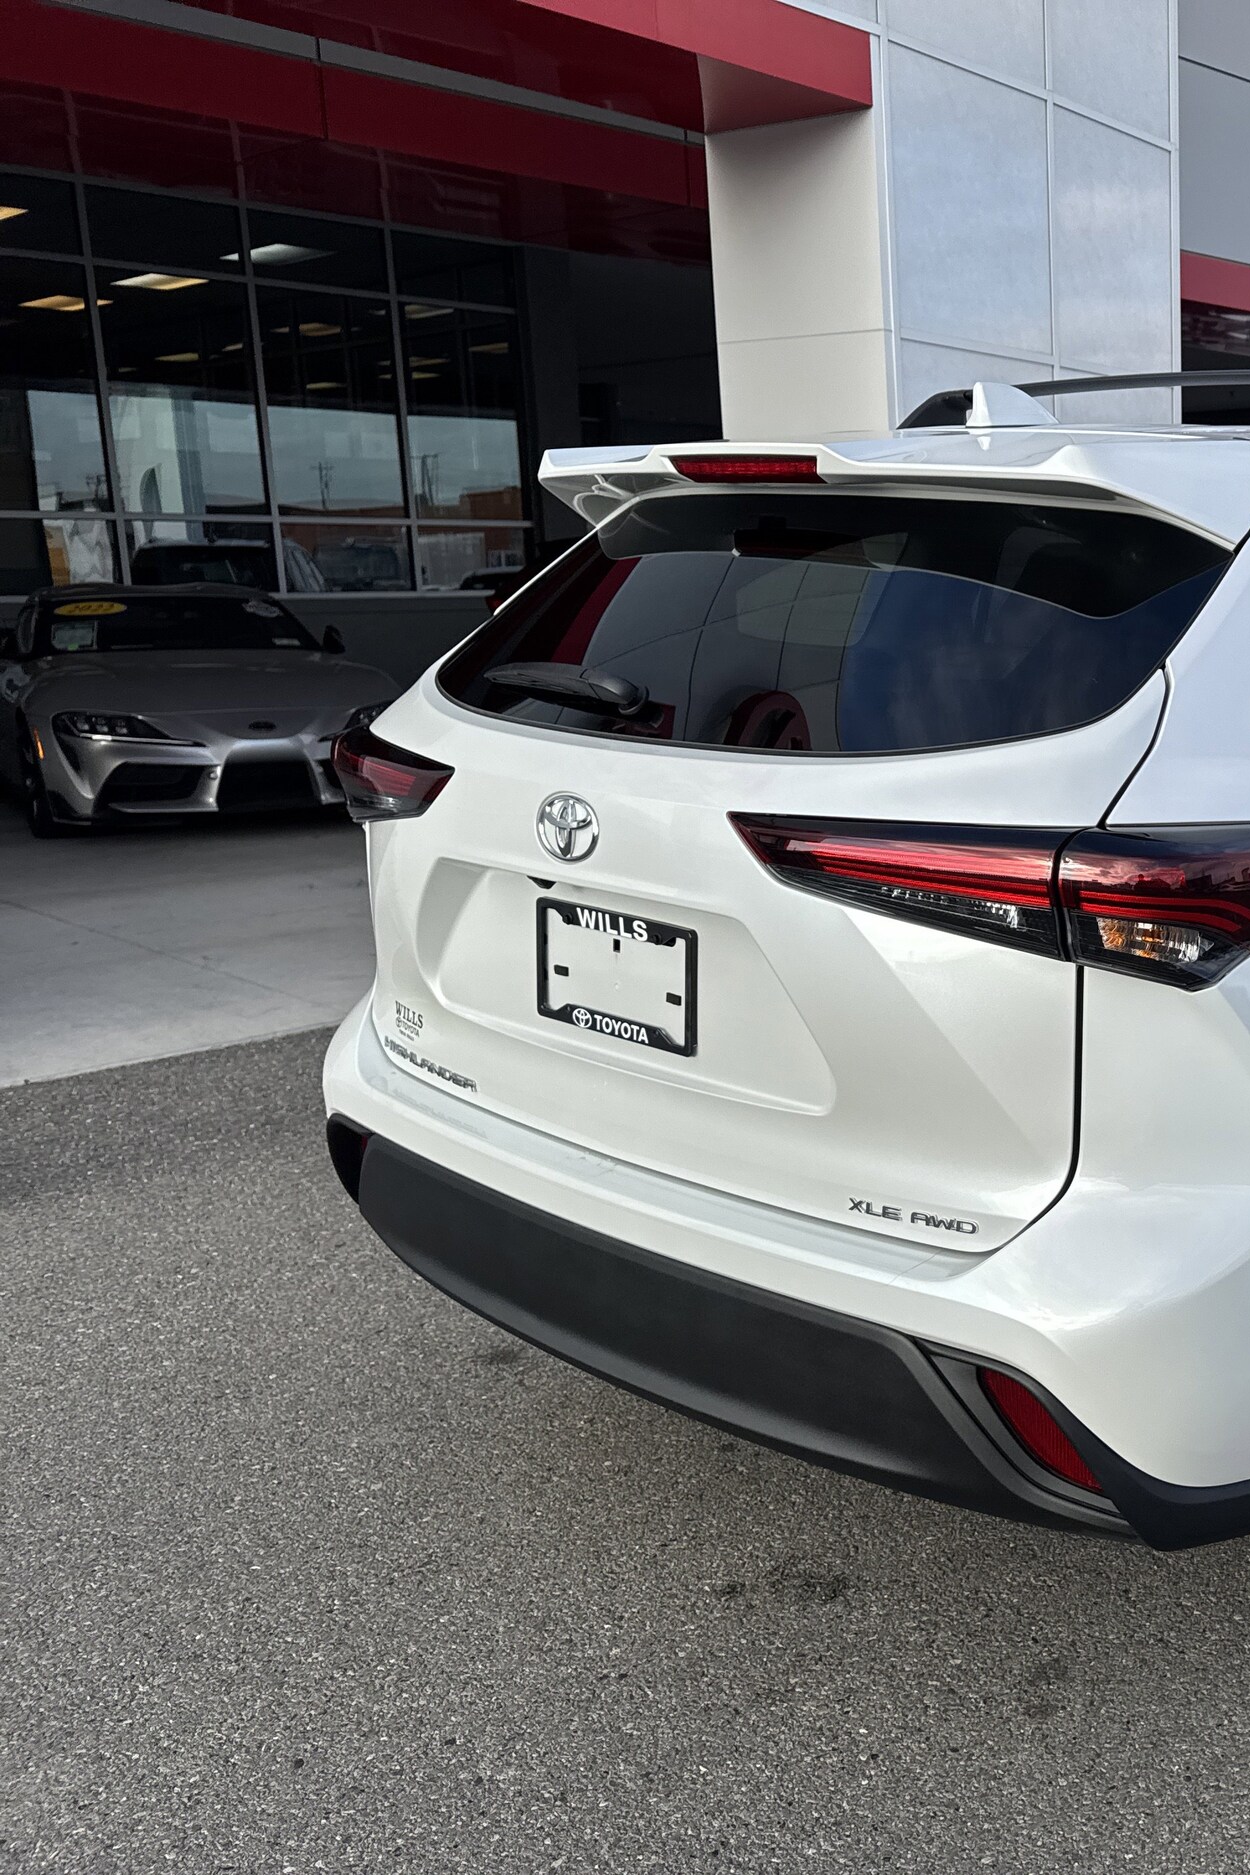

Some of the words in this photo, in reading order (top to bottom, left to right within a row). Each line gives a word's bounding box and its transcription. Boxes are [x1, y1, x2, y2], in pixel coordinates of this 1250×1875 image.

[576, 907, 648, 941] WILLS
[395, 1000, 423, 1029] WILLS
[594, 1014, 649, 1043] TOYOTA
[849, 1197, 902, 1221] XLE
[911, 1211, 979, 1235] AWD
